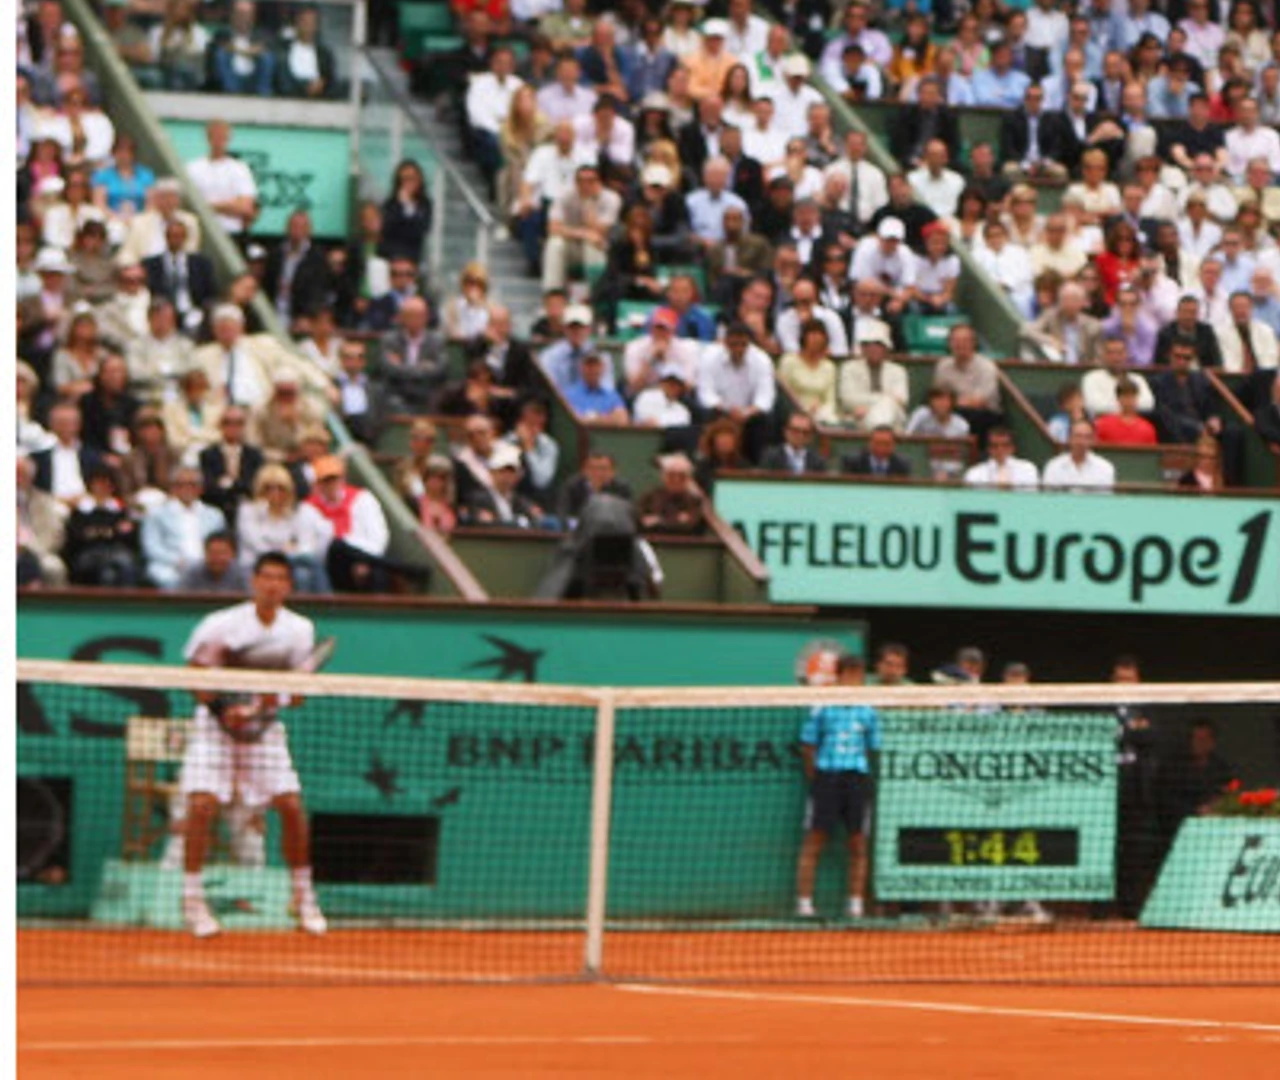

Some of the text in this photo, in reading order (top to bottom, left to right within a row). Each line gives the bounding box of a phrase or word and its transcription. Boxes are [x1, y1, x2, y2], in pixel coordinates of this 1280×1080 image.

[448, 734, 567, 769] BNP
[882, 749, 1107, 784] LONGINES
[946, 831, 1041, 866] 1:44
